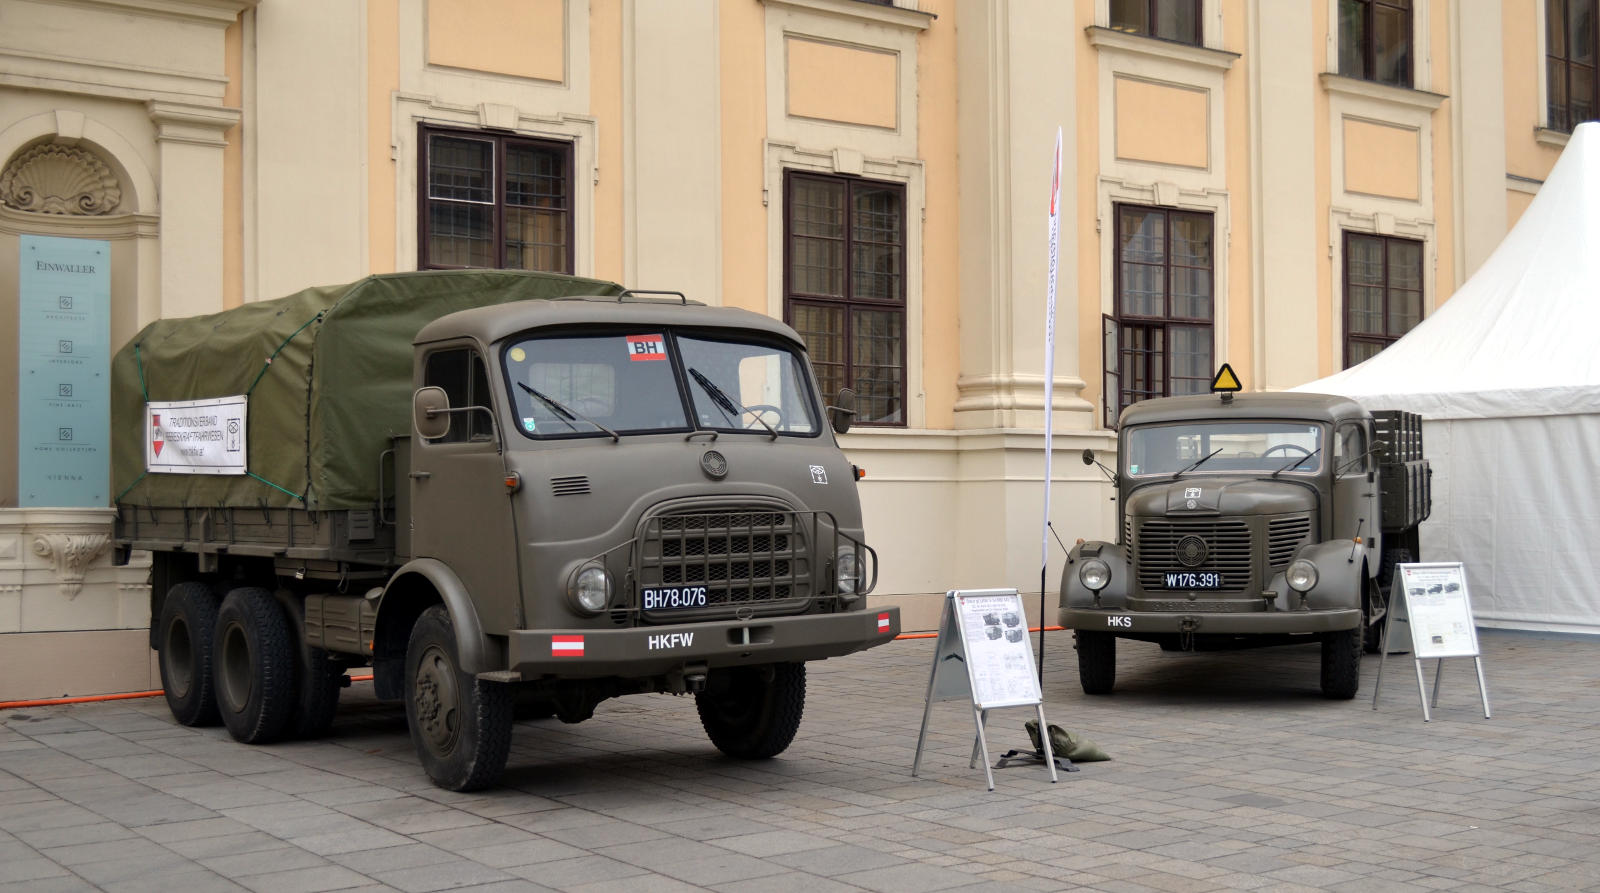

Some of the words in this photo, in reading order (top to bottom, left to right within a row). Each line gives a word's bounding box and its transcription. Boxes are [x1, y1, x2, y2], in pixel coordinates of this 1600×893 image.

[36, 260, 96, 274] EINWALLER
[634, 341, 658, 355] BH
[1166, 573, 1219, 587] W176.391
[644, 587, 706, 609] BH78.076
[1107, 616, 1132, 628] HKS
[648, 632, 694, 651] HKFW
